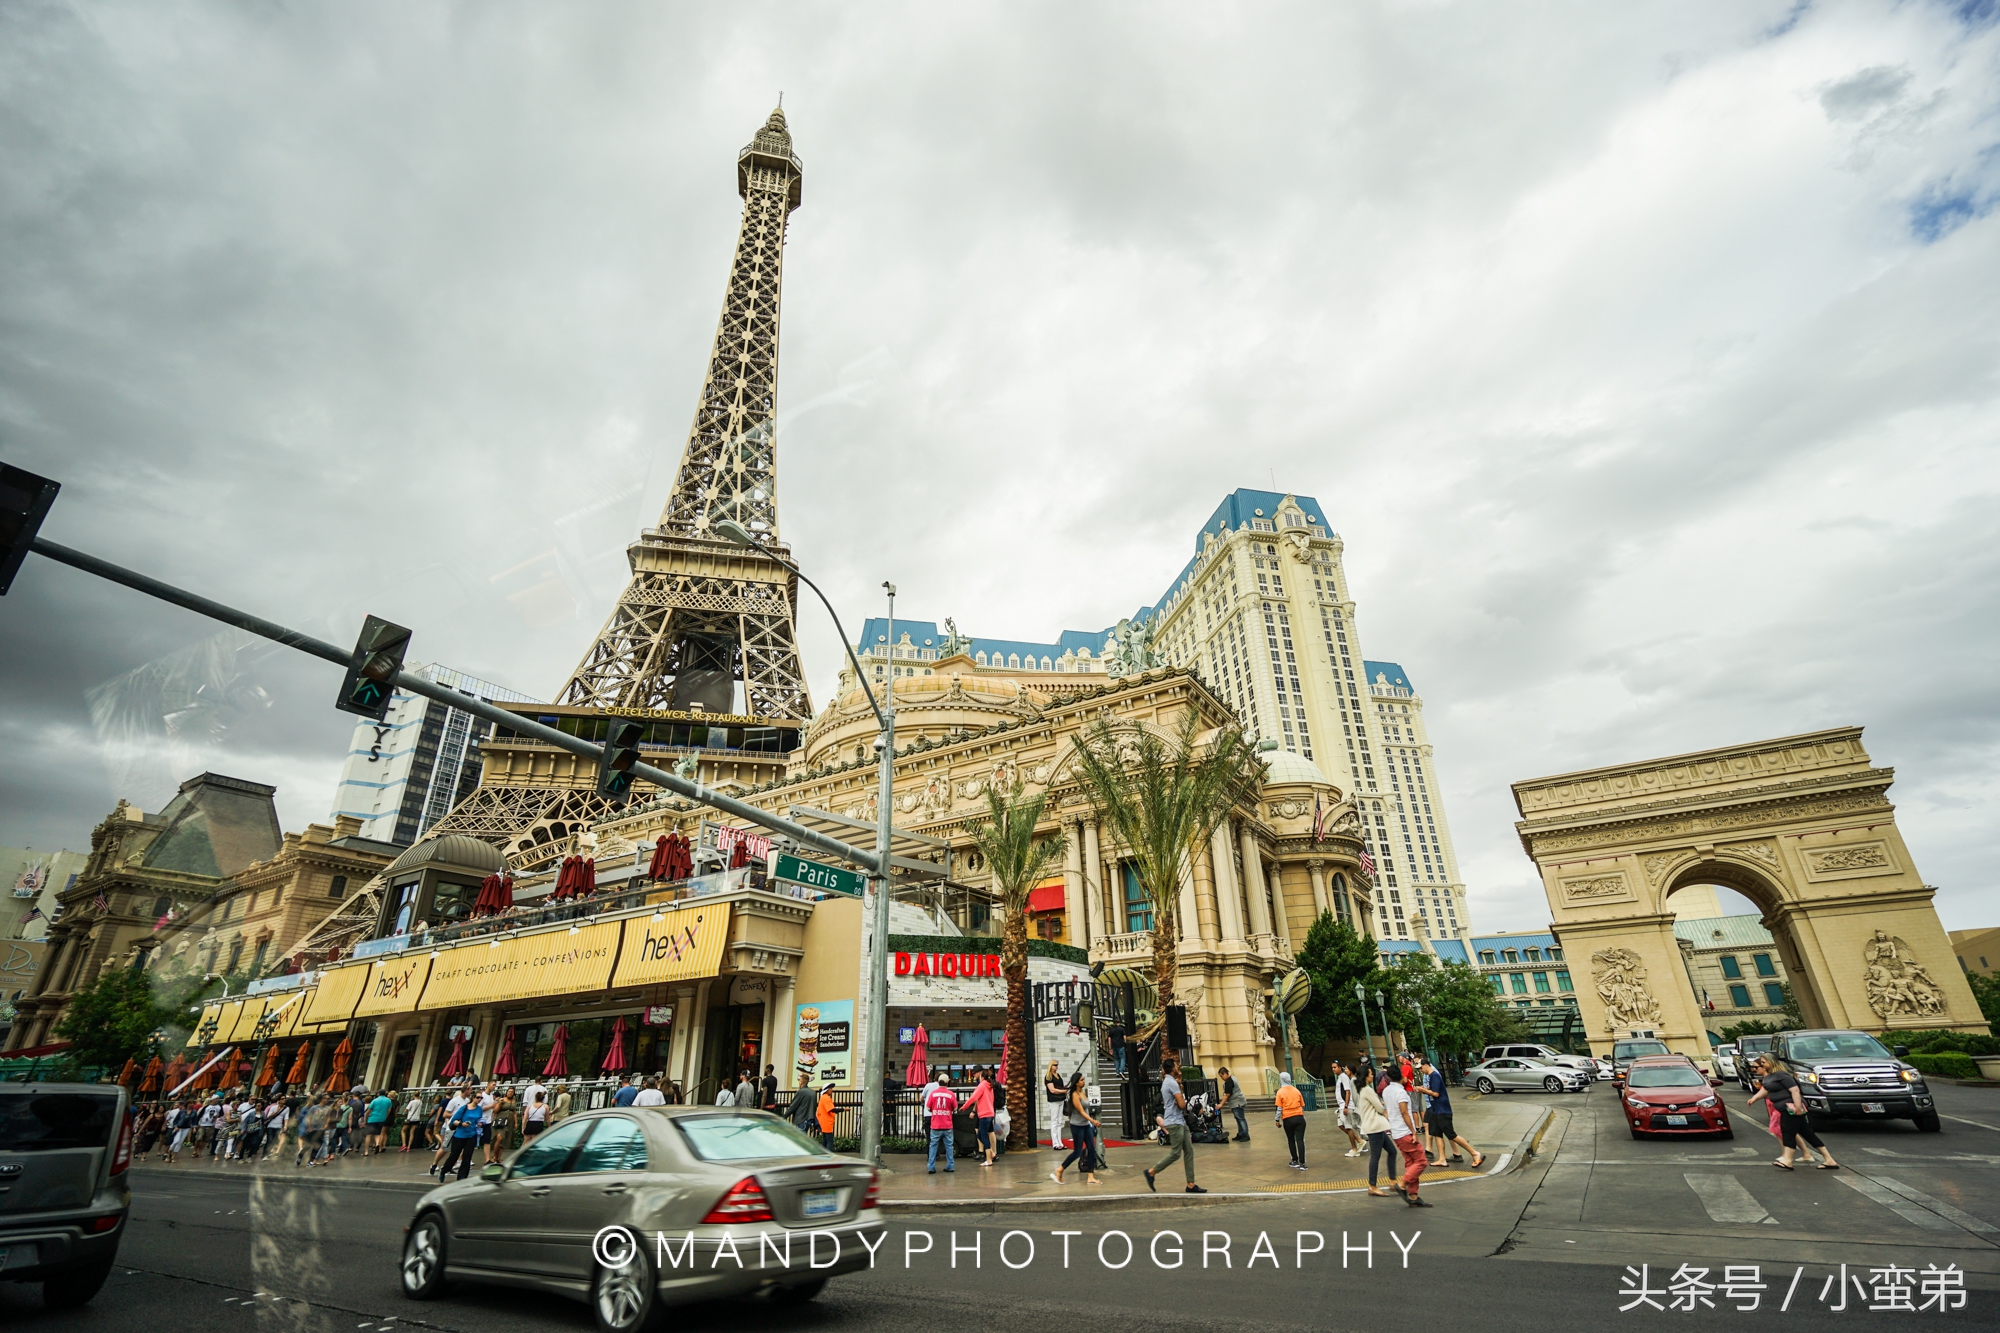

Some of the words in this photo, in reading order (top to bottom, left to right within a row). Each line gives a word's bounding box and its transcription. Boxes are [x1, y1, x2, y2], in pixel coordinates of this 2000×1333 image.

[605, 706, 644, 717] EIFFEL
[647, 707, 687, 719] TOWER
[691, 711, 760, 724] RESTAURANT
[746, 832, 772, 861] PARK
[778, 854, 783, 863] E
[796, 862, 838, 888] Paris
[856, 874, 864, 883] DR
[436, 969, 462, 981] CRAFT
[465, 960, 520, 977] CHOCOLATE
[894, 951, 1001, 979] DAIQUIR
[524, 989, 544, 997] PASTRIES
[552, 987, 567, 995] GIFTS
[576, 983, 596, 992] APPAREL
[627, 975, 658, 985] CHOCOLATE
